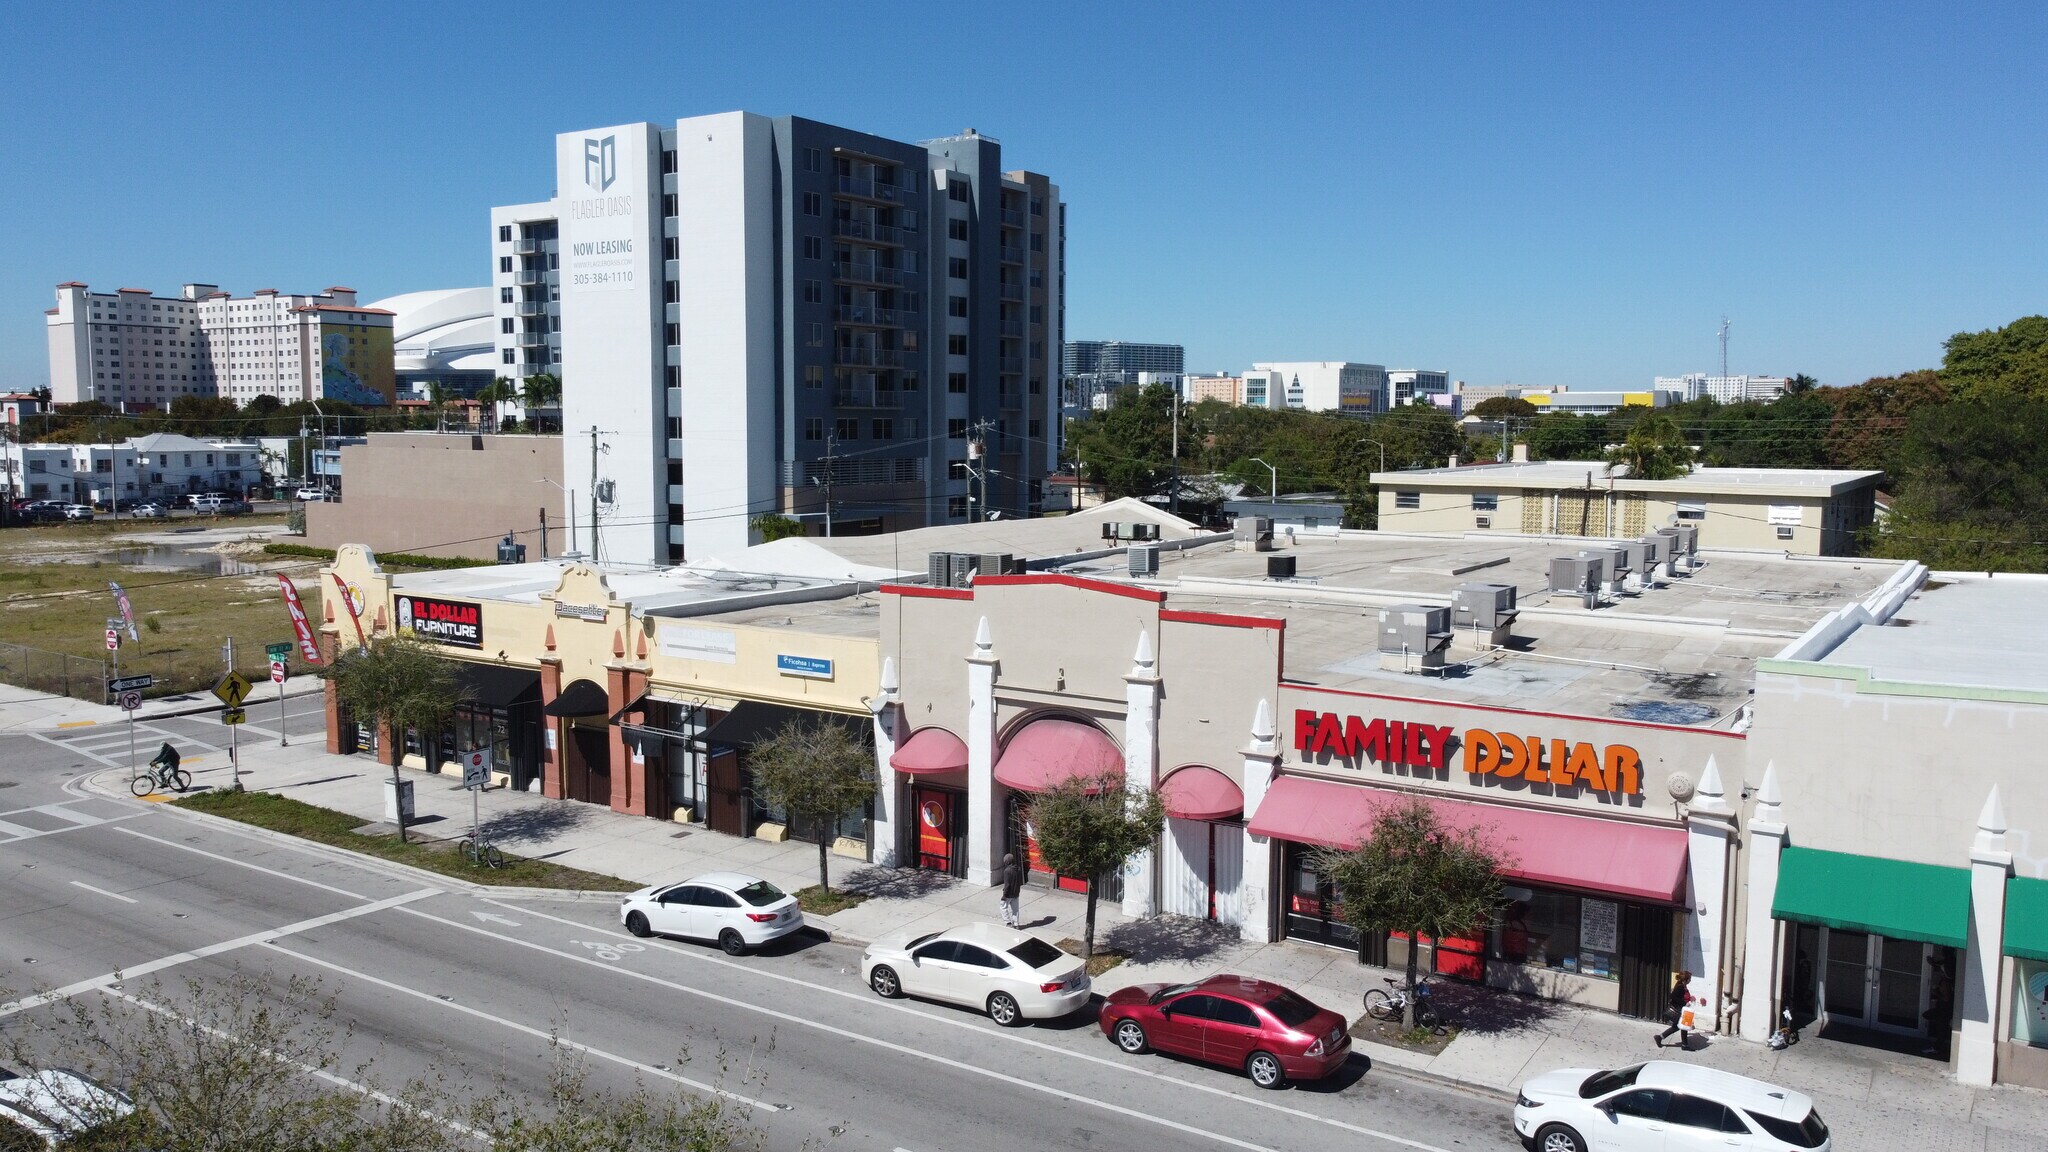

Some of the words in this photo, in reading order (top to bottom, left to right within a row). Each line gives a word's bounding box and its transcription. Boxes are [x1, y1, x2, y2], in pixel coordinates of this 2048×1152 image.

[572, 198, 605, 220] FLAGLER
[607, 195, 632, 217] OASIS
[573, 242, 594, 256] NOW
[596, 239, 633, 254] LEASING
[573, 270, 634, 285] 305-384-1110
[414, 601, 427, 619] EL
[429, 602, 477, 625] DOLLAR
[416, 618, 477, 638] FURNITURE
[1294, 709, 1455, 768] FAMILY
[1463, 728, 1639, 794] DOLLAR
